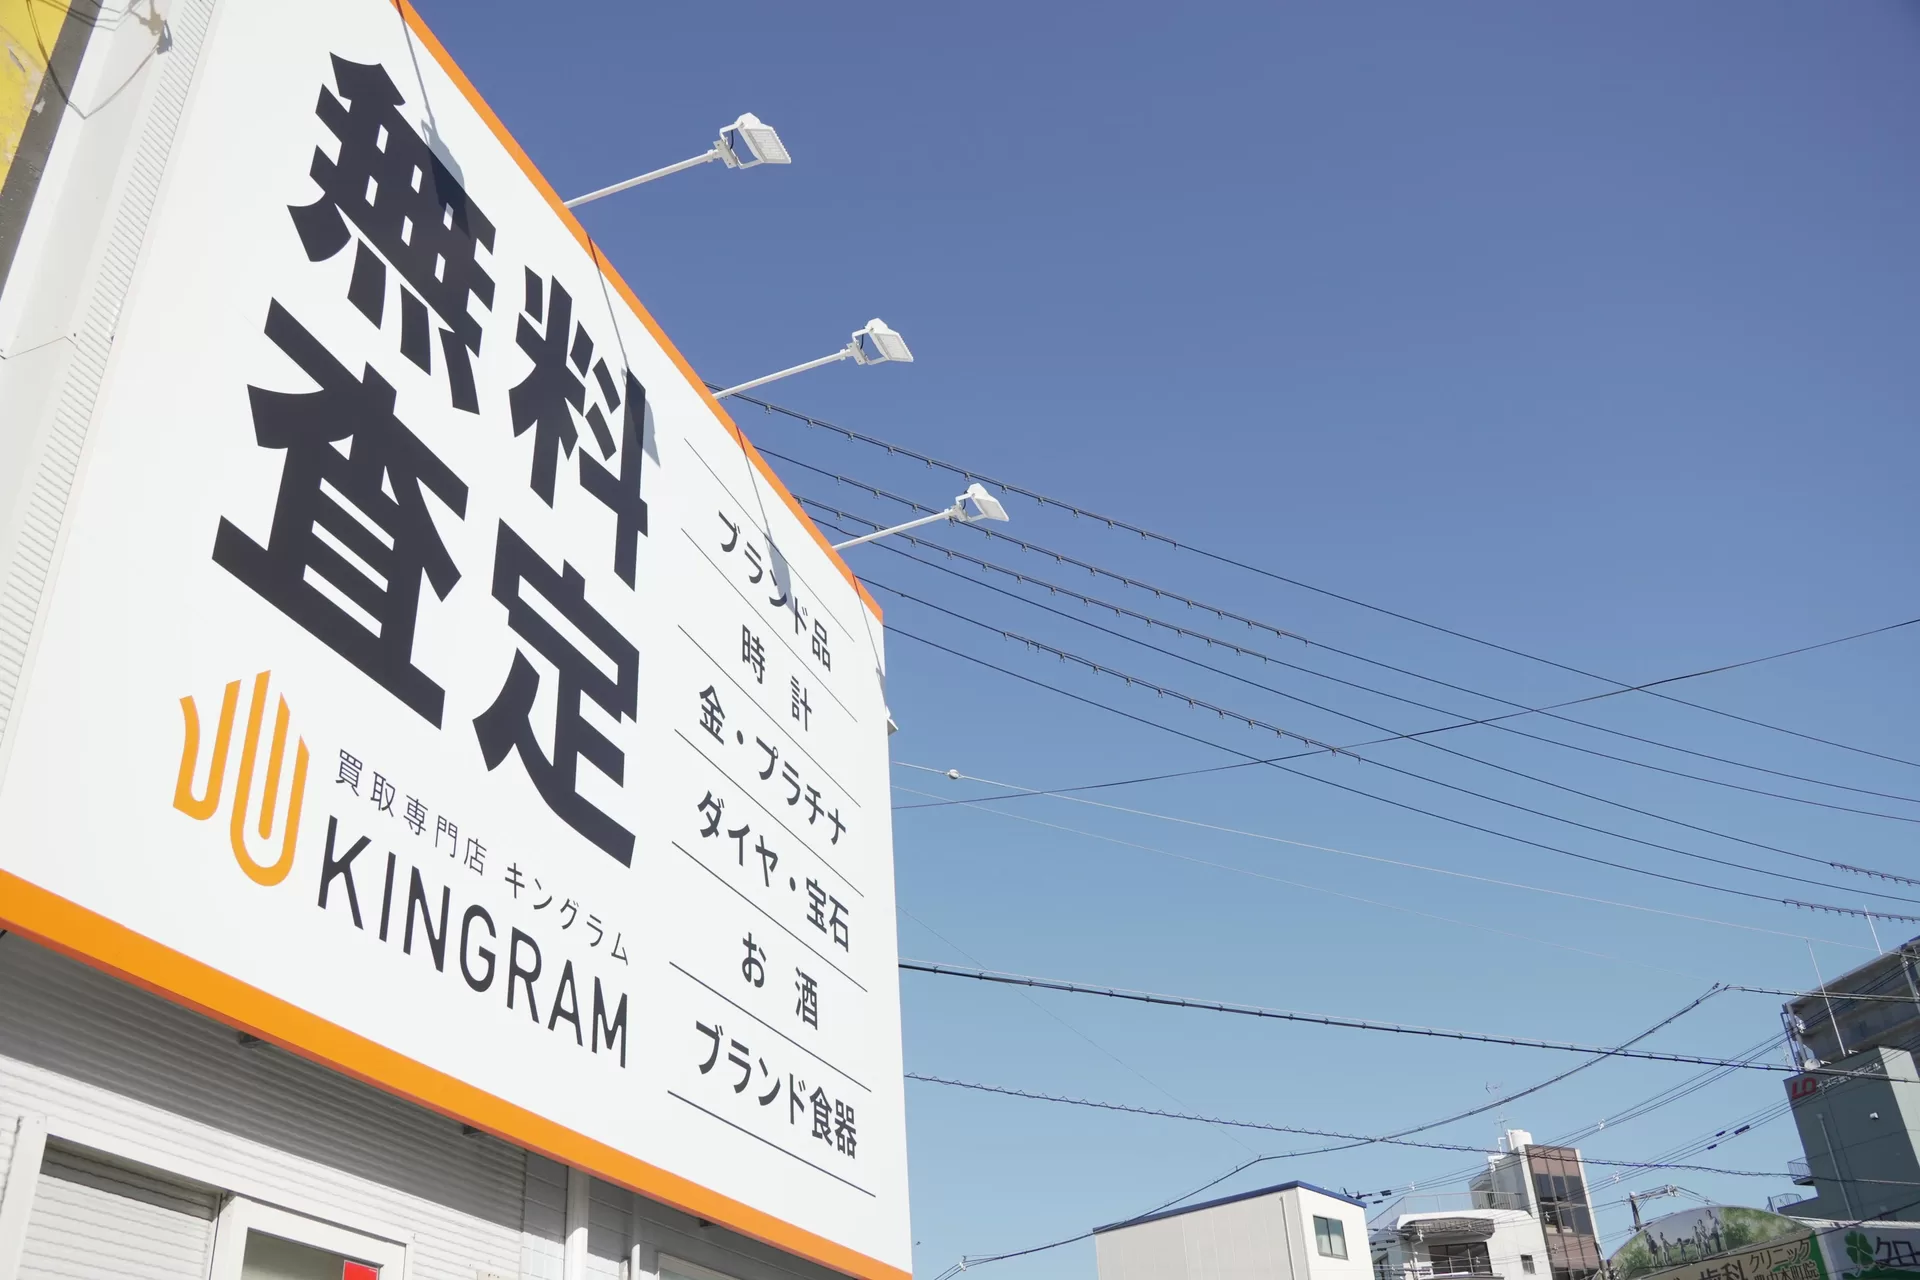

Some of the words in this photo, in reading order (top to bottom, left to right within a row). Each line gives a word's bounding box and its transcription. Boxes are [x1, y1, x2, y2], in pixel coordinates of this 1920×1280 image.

[287, 51, 649, 592] 無料
[211, 296, 640, 869] 査定
[718, 510, 831, 672] ブランド品
[742, 624, 812, 731] 時計
[699, 685, 846, 845] 金・プラチナ
[335, 748, 487, 876] 買取専門店
[504, 862, 629, 966] キングラム
[697, 790, 849, 953] ダイヤ・宝石
[317, 814, 628, 1069] KINGRAM
[741, 932, 818, 1030] お酒
[696, 1020, 857, 1159] ブランド食器
[1749, 1240, 1809, 1273] クリニック
[1875, 1236, 1920, 1266] クロ
